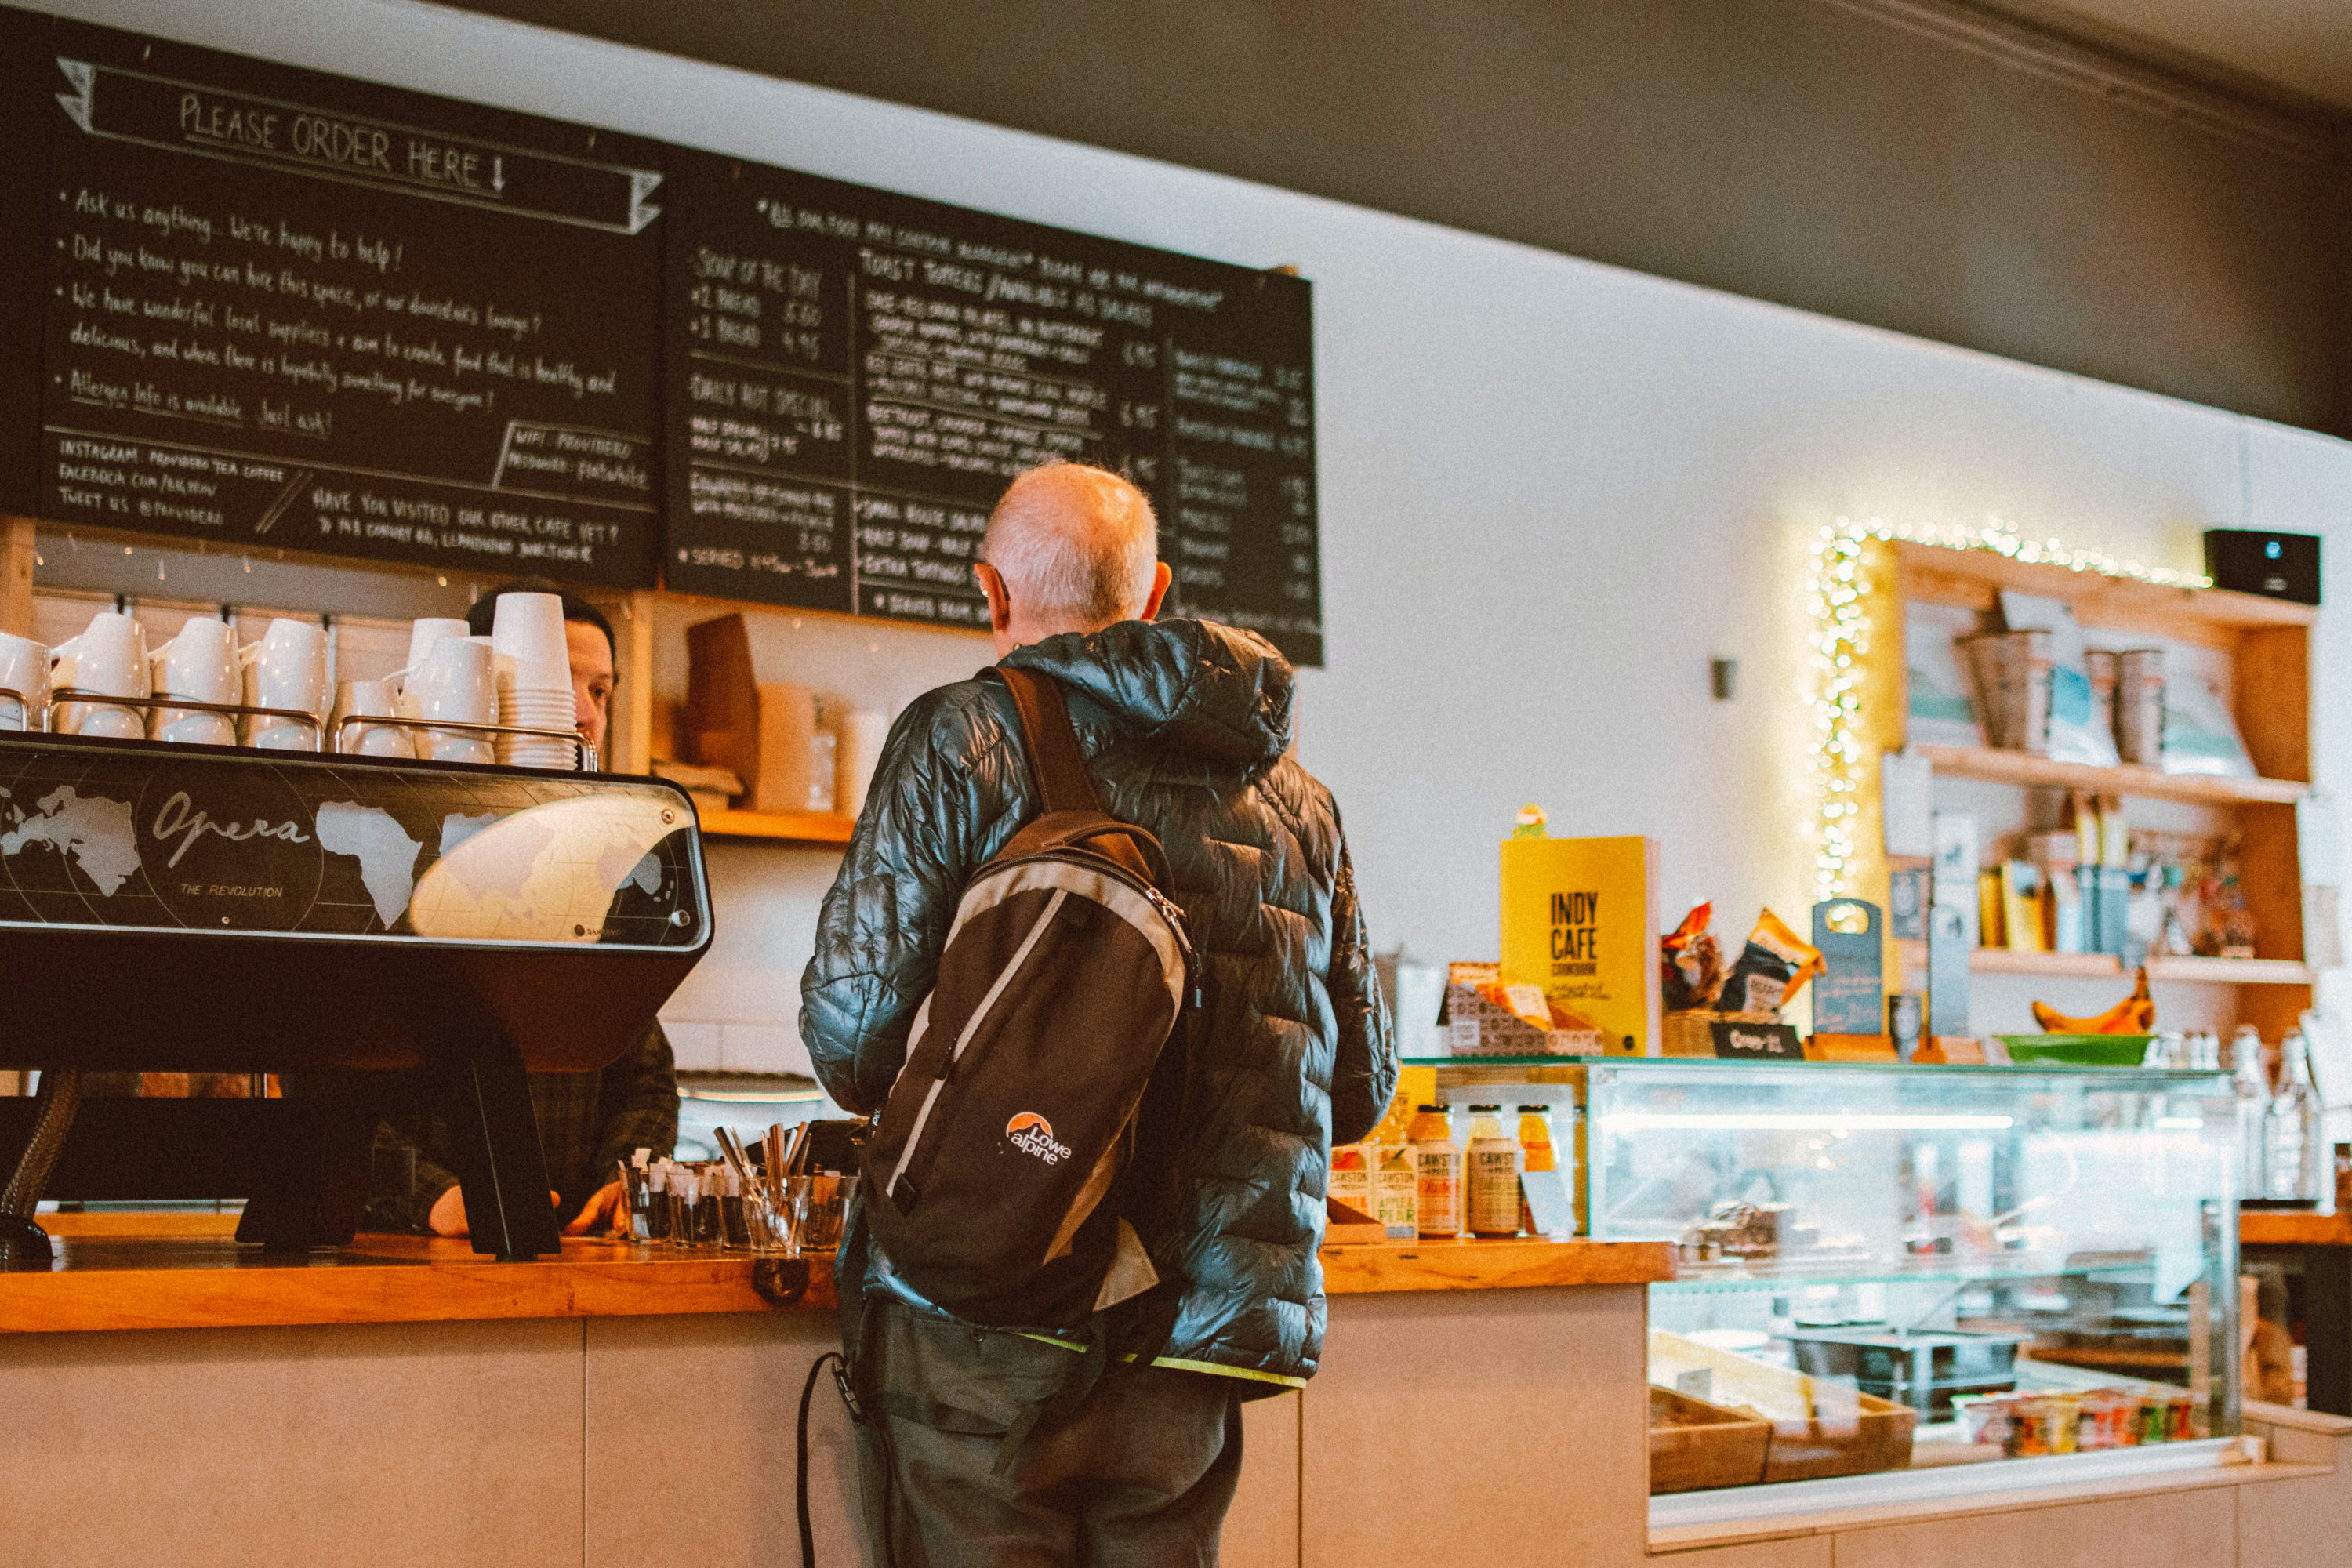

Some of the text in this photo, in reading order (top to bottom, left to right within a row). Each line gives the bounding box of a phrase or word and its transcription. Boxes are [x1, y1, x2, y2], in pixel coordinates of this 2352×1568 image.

[181, 93, 480, 188] PLEASE ORDER HERE
[75, 188, 107, 218] Ask
[114, 203, 135, 220] us
[279, 218, 322, 263] happy
[330, 229, 350, 259] to
[73, 234, 100, 261] Did
[105, 248, 133, 277] you
[138, 245, 174, 272] know
[179, 260, 208, 285] you
[212, 263, 238, 284] can
[246, 260, 274, 292] hire
[279, 268, 305, 299] this
[859, 246, 914, 281] TOAST
[72, 281, 95, 309] We
[103, 285, 136, 316] have
[143, 298, 215, 330] wonderful
[225, 304, 260, 333] local
[267, 316, 330, 347] suppliers
[454, 345, 482, 376] food
[535, 355, 583, 401] healthy
[151, 338, 178, 361] and
[70, 368, 129, 408] Allergen
[59, 484, 102, 510] TWEET
[108, 495, 129, 513] US
[314, 486, 351, 513] HAVE
[361, 490, 390, 518] YOU
[391, 496, 450, 526] VISITED
[489, 512, 532, 536] OTHER
[152, 790, 311, 869] Opera
[180, 883, 283, 898] THE REVOLUTION
[1550, 891, 1599, 927] INDY
[1550, 927, 1598, 961] CAFE
[1011, 1132, 1058, 1166] alpine
[1029, 1126, 1072, 1160] Lowe
[1377, 1209, 1415, 1223] PEAR
